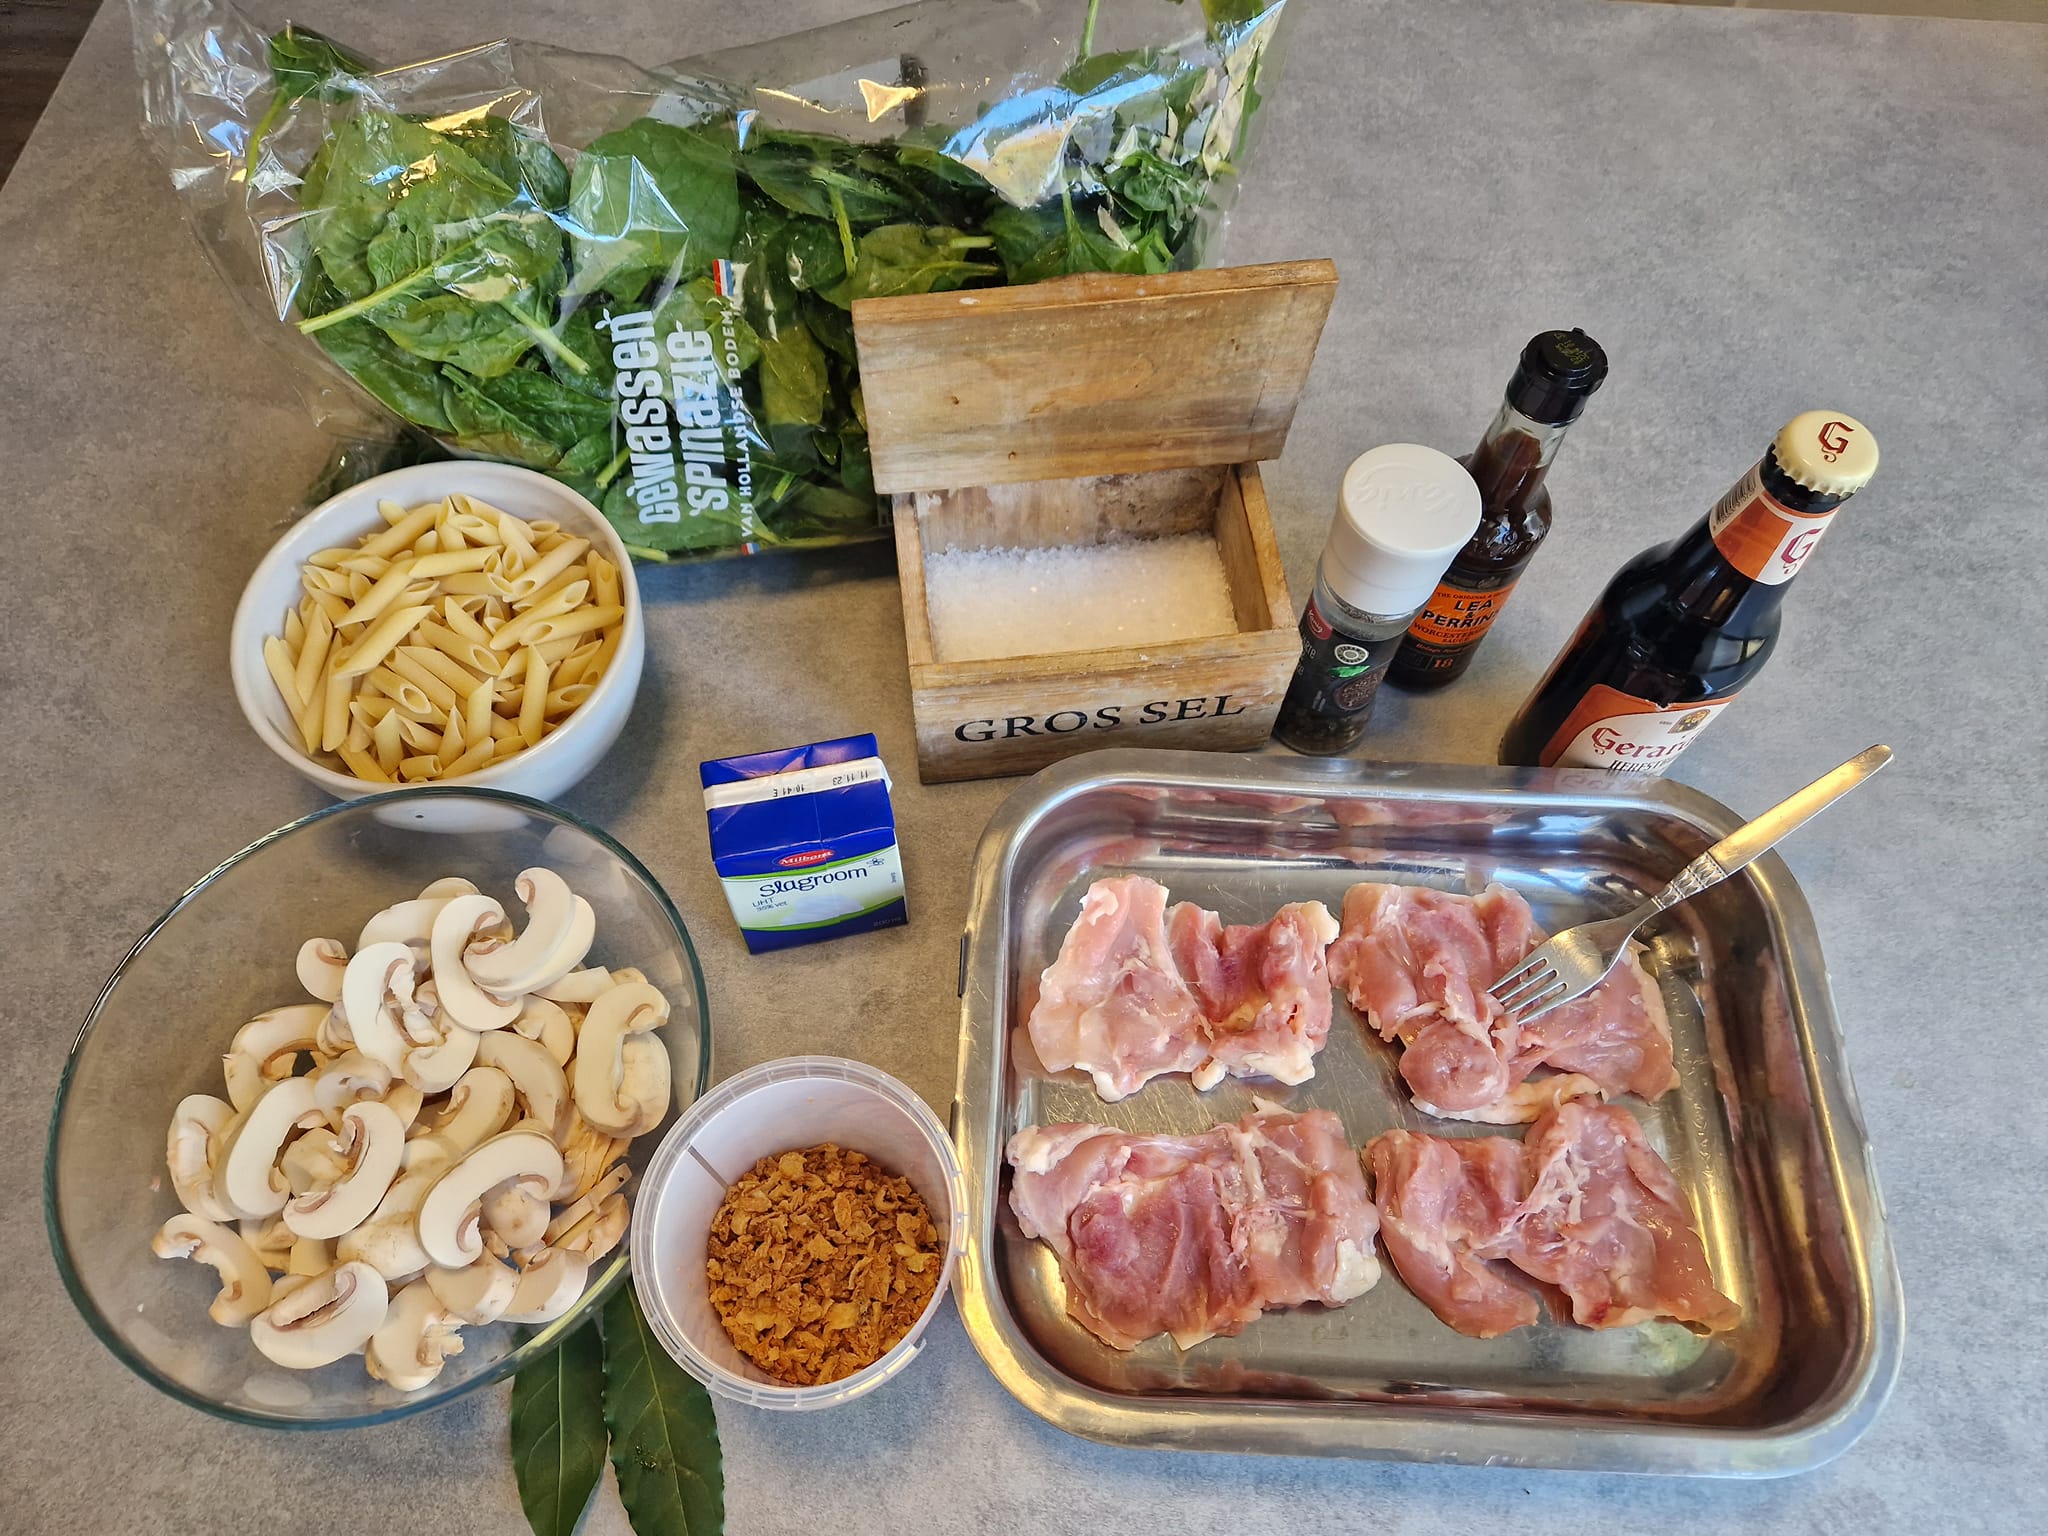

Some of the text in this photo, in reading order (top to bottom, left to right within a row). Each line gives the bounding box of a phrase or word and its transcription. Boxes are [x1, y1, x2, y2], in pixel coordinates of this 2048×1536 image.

[718, 309, 754, 538] VAN HOLLANDSE BODEM
[1818, 421, 1855, 463] G
[1454, 599, 1494, 612] LEA
[1465, 611, 1475, 619] &
[954, 694, 1247, 743] GROS SEL
[759, 867, 868, 898] Slagroom
[752, 897, 774, 908] UHT
